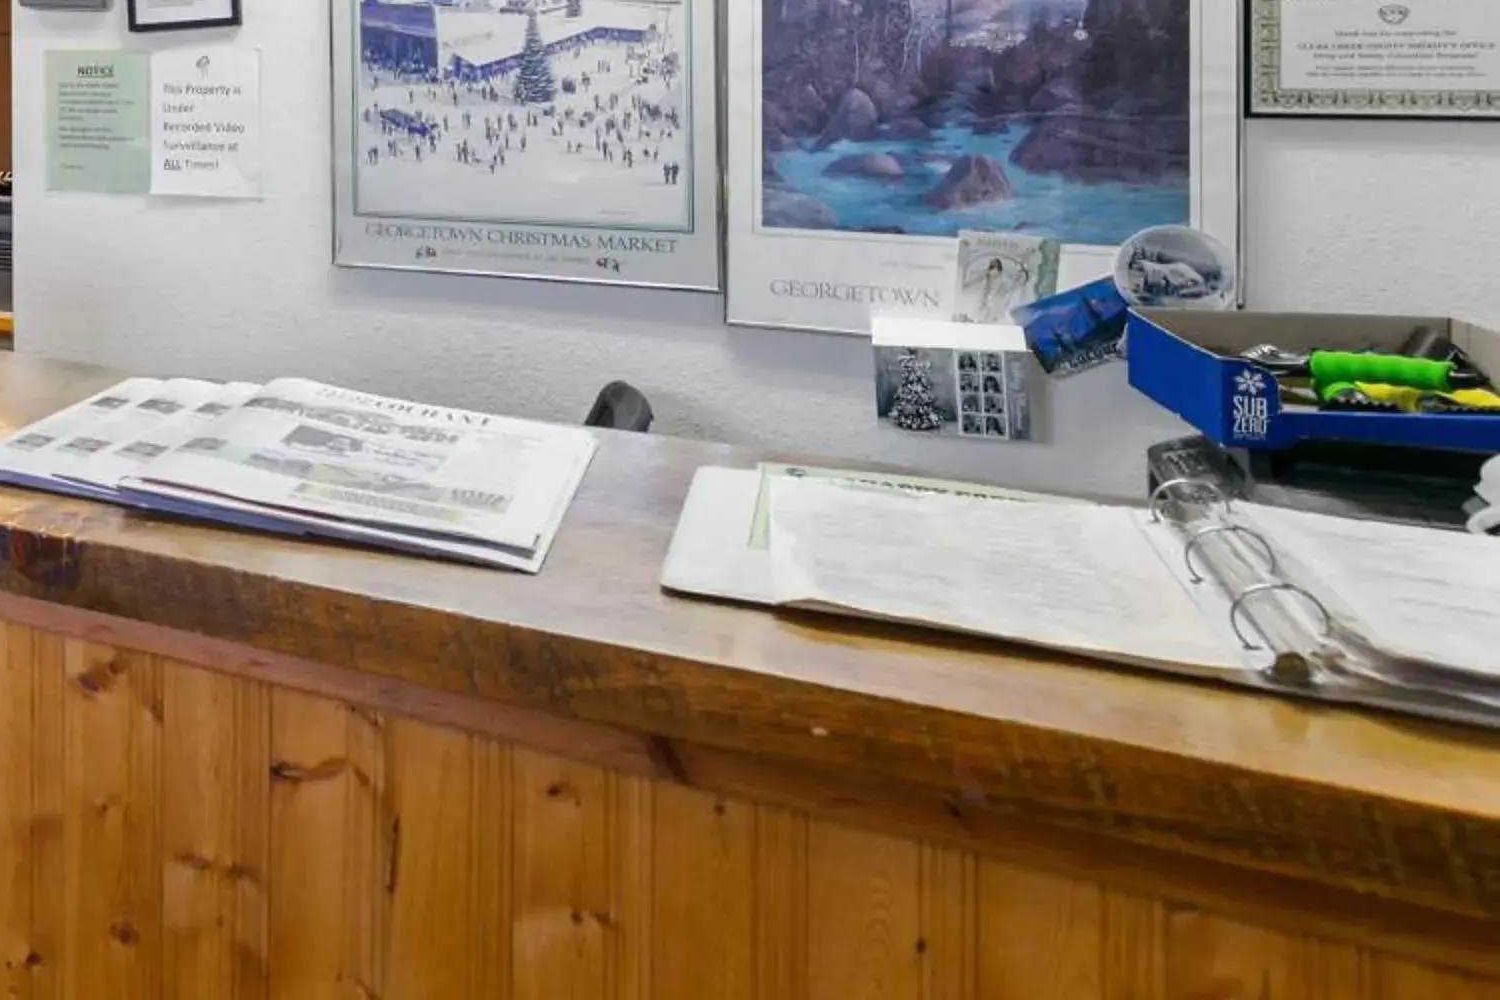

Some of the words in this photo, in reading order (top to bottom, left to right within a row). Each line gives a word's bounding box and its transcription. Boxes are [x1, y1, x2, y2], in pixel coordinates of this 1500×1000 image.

[77, 64, 115, 78] NOTICE
[185, 83, 231, 97] Property
[163, 103, 195, 113] Under
[163, 121, 214, 133] Recorded
[215, 121, 246, 134] Video
[365, 222, 483, 243] GEORGETOWN
[487, 229, 591, 249] CHRISTMAS
[597, 234, 678, 253] MARKET
[769, 278, 941, 308] GEORGETOWN
[1233, 395, 1267, 419] SUB
[1232, 416, 1269, 435] ZERO
